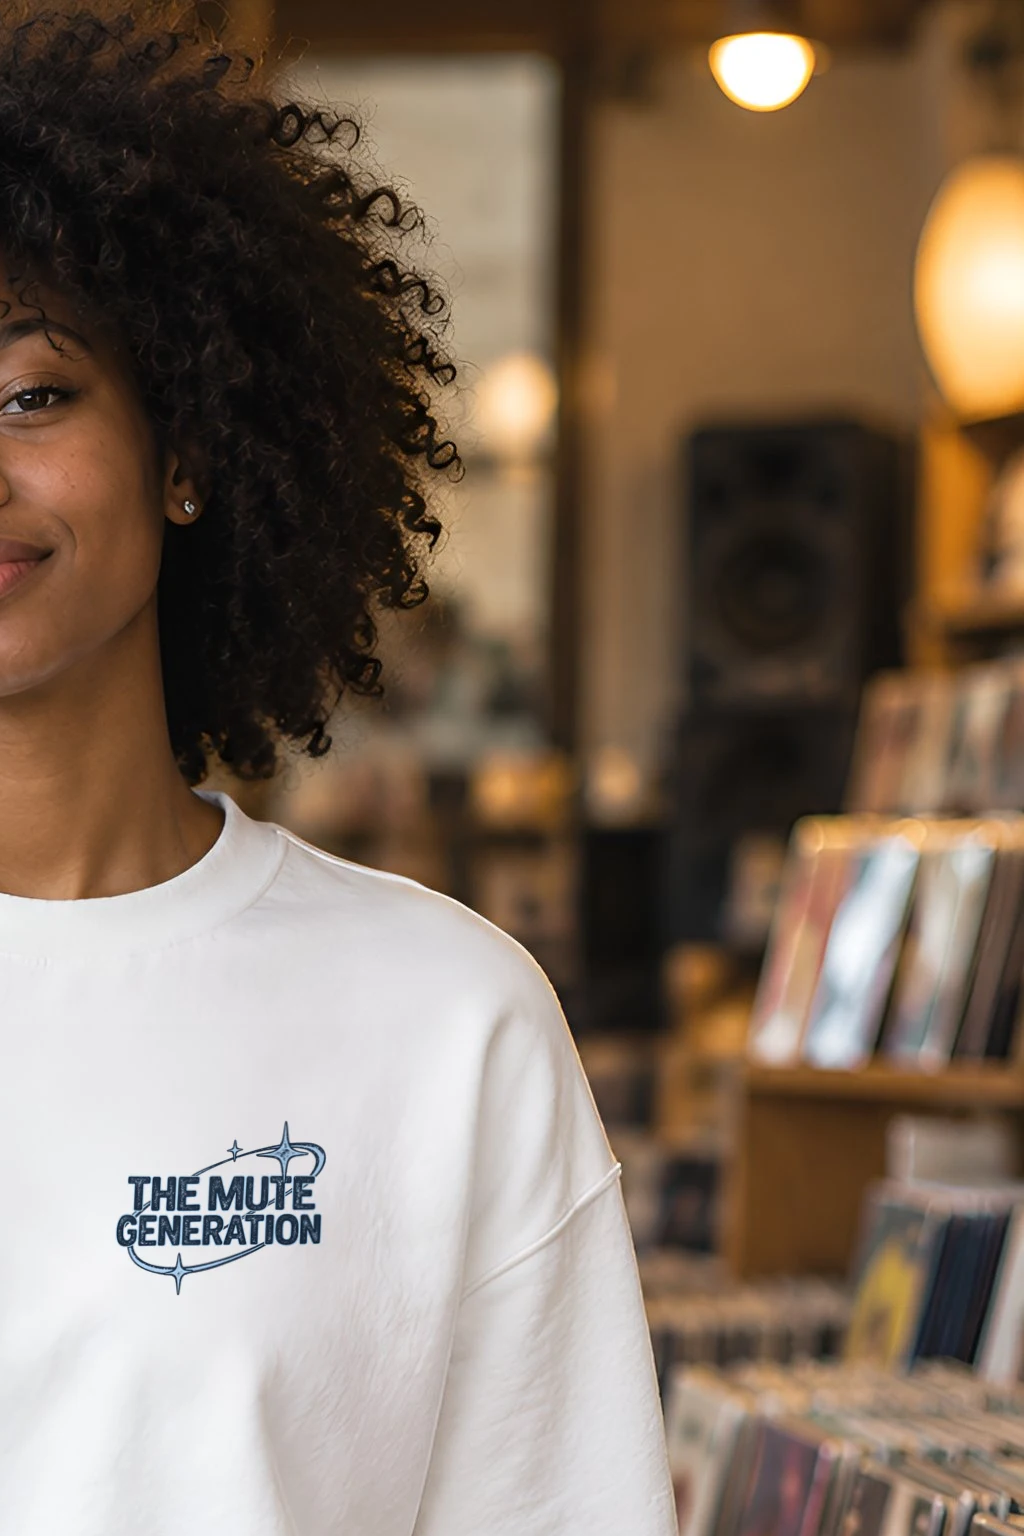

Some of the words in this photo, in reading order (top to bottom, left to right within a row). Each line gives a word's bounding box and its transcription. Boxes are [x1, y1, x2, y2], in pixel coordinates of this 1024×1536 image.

[128, 1176, 200, 1211] THE
[208, 1176, 315, 1211] MUTE
[116, 1214, 321, 1246] GENERATION
